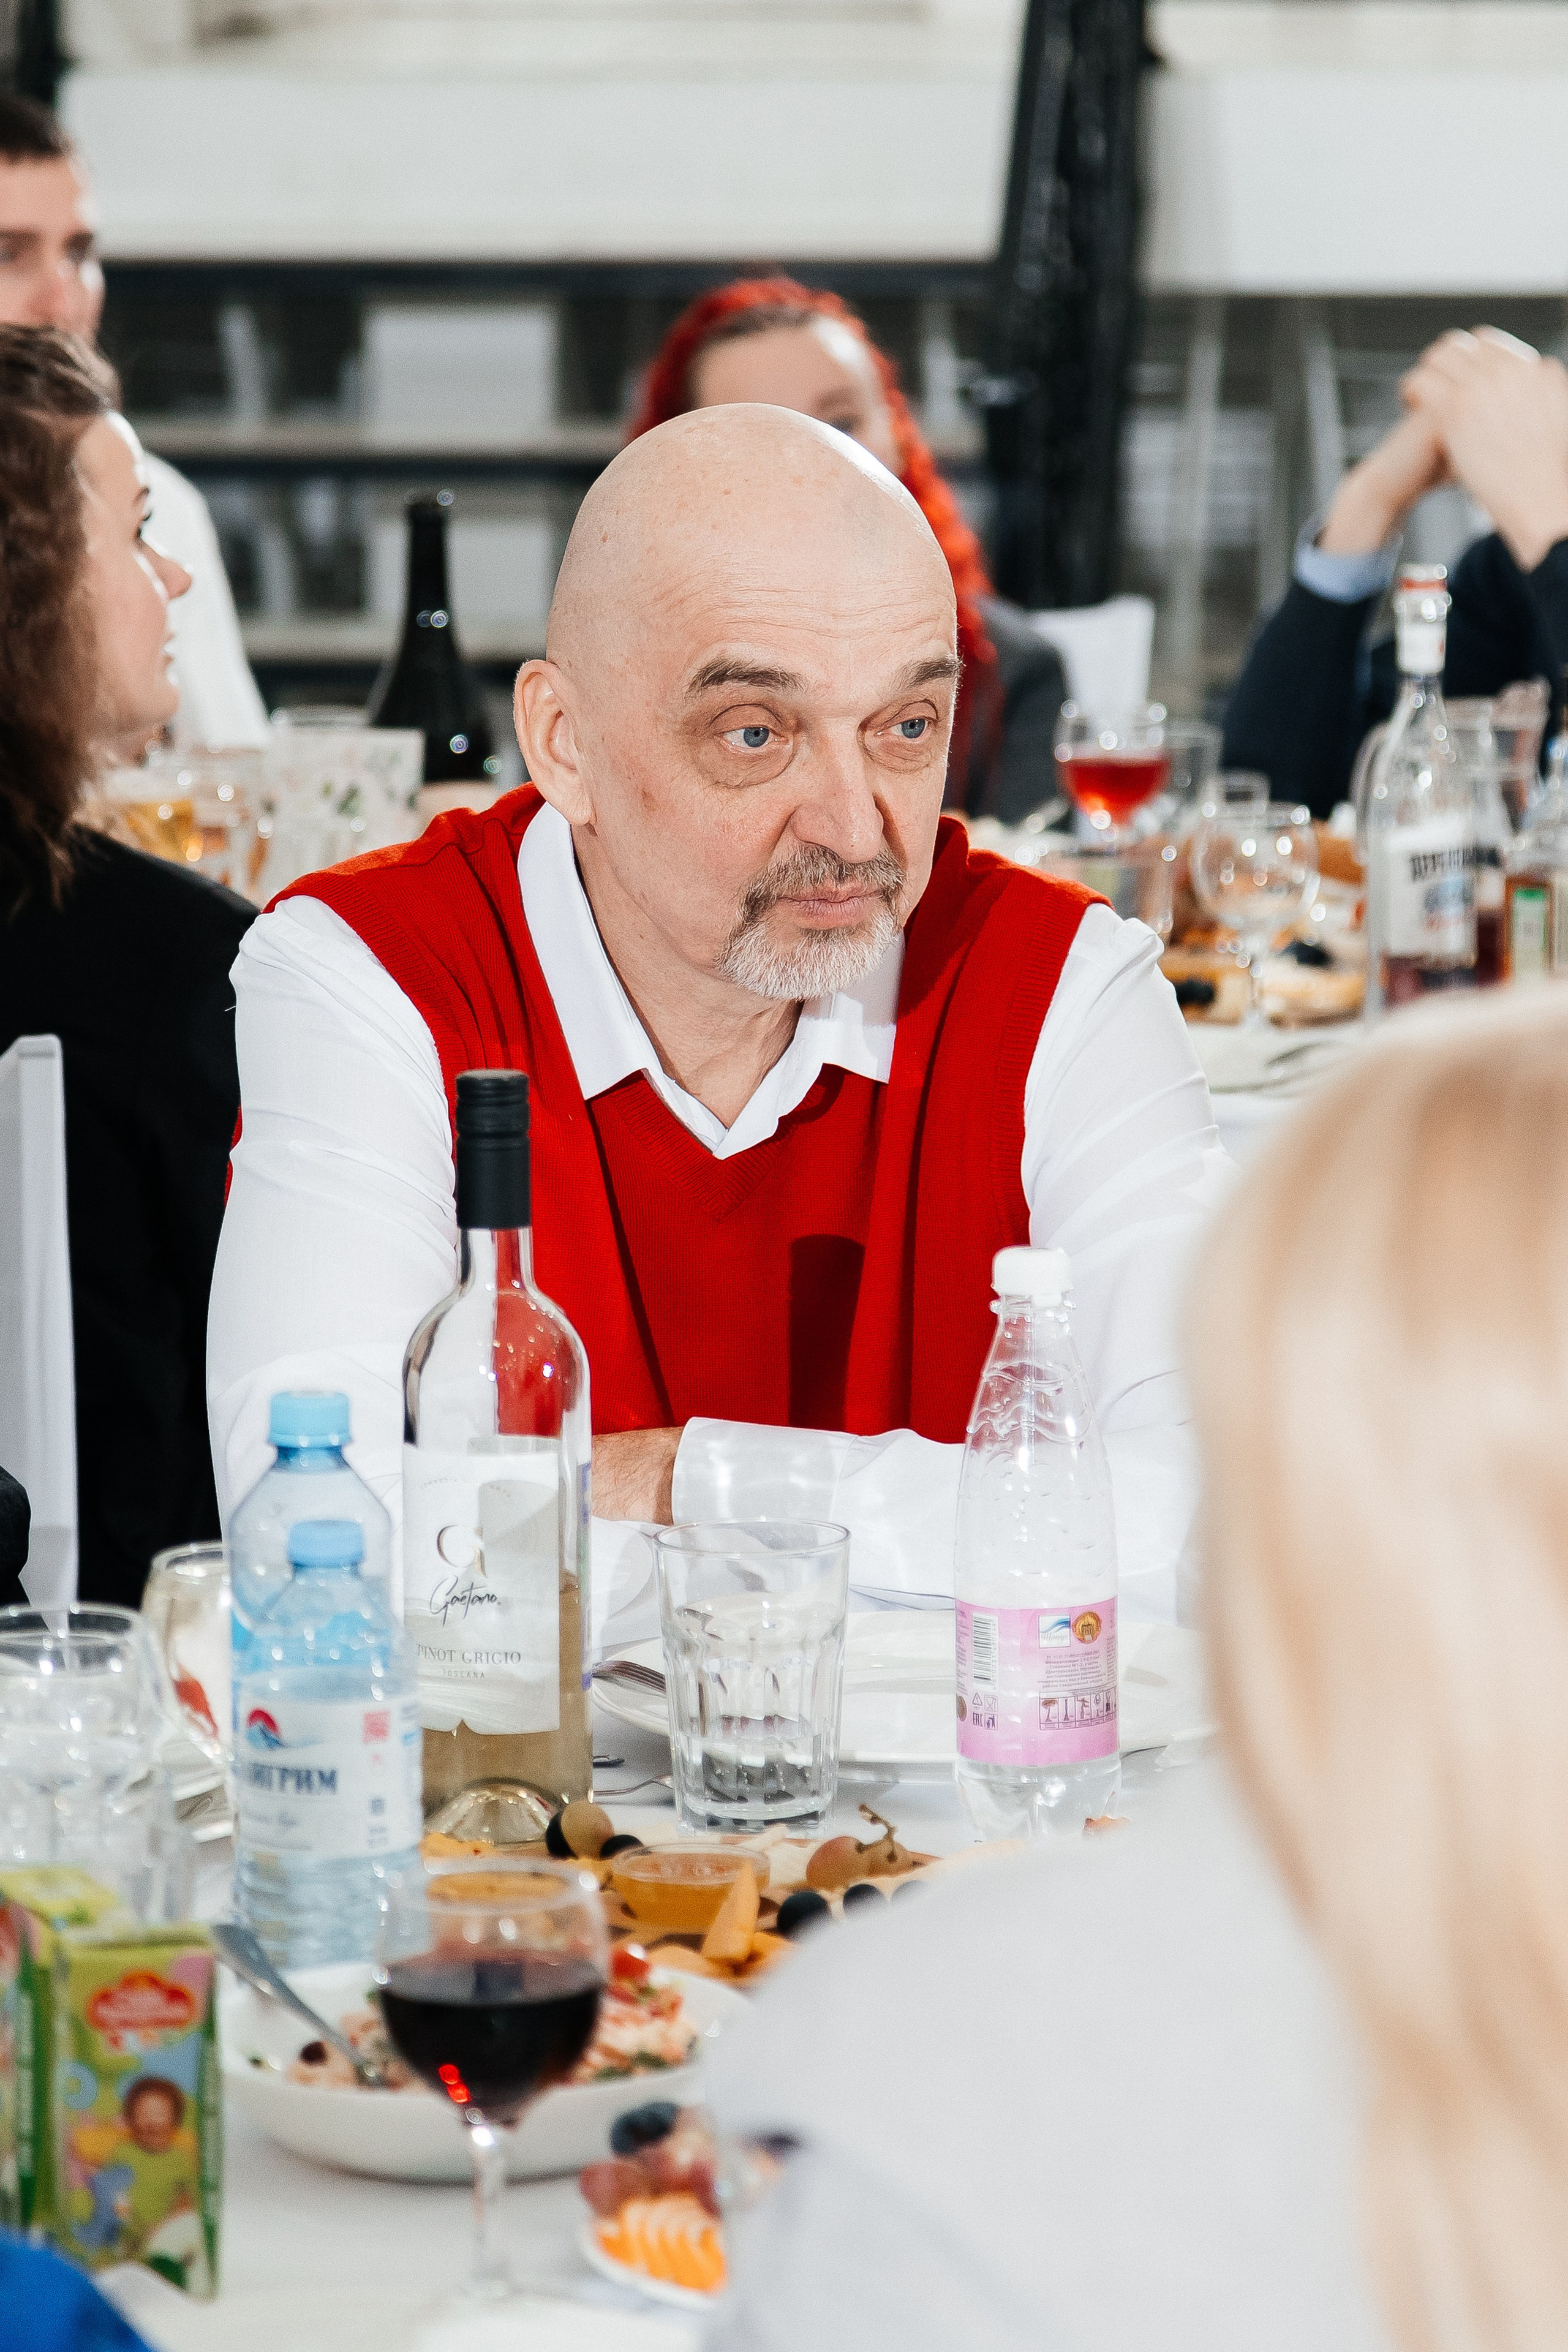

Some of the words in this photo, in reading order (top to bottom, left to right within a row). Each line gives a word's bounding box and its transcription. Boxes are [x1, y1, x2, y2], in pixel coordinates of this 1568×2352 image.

[417, 1644, 456, 1662] PINOT
[462, 1651, 521, 1665] GRIGIO
[443, 1669, 485, 1679] TOSCANA
